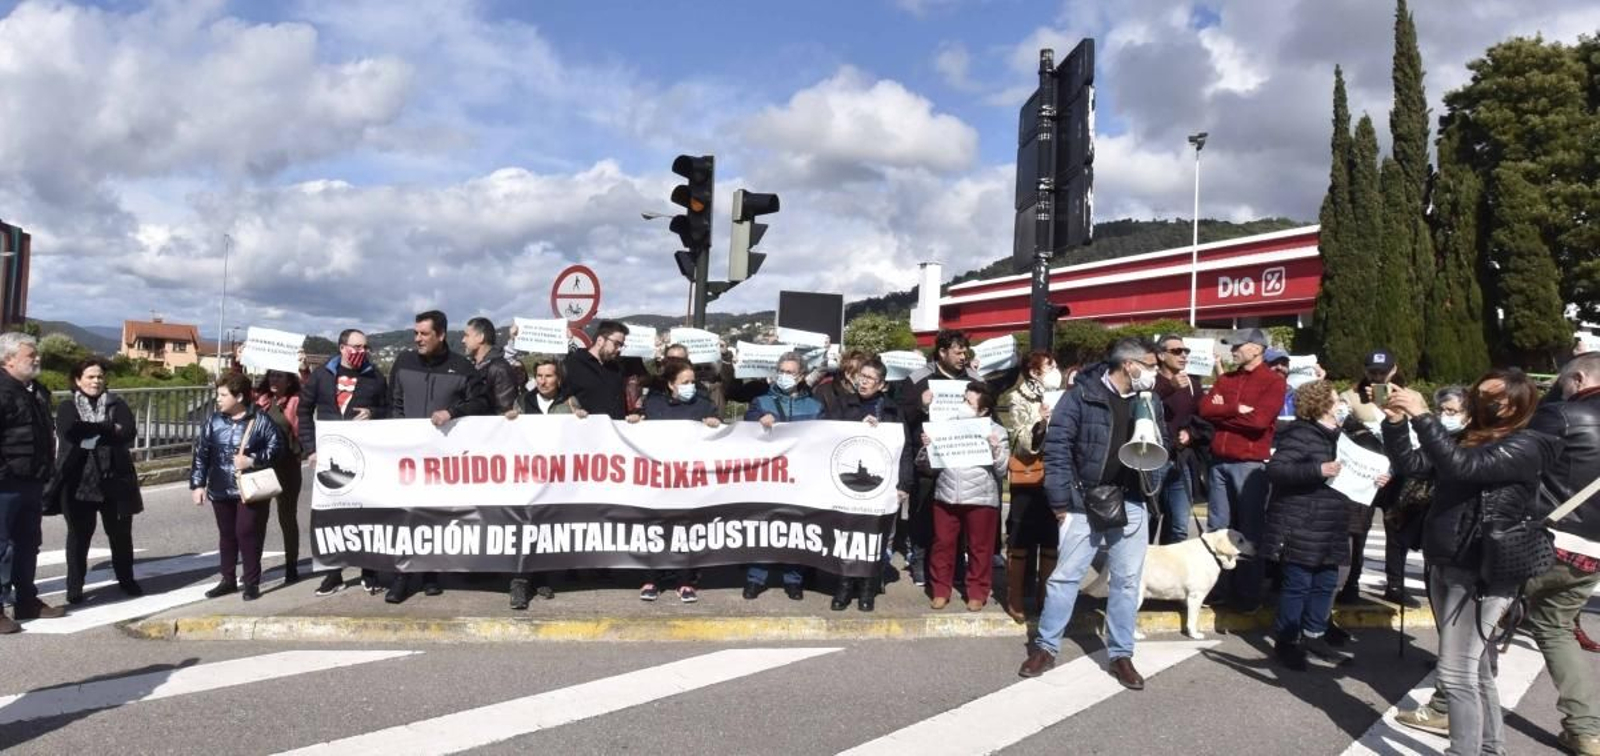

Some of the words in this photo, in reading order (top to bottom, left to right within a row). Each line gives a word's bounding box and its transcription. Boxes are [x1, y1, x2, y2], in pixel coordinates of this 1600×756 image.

[399, 457, 417, 486] O
[424, 451, 508, 485] RUÍDO
[513, 454, 566, 484] NON
[573, 453, 626, 484] NOS
[633, 456, 709, 488] DEIXA
[714, 454, 796, 485] VIVIR.
[315, 519, 480, 556] INSTALACIÓN
[486, 523, 517, 555] DE
[521, 522, 665, 556] PANTALLAS
[670, 517, 829, 557] ACÚSTICAS,
[832, 529, 883, 562] XA!!
